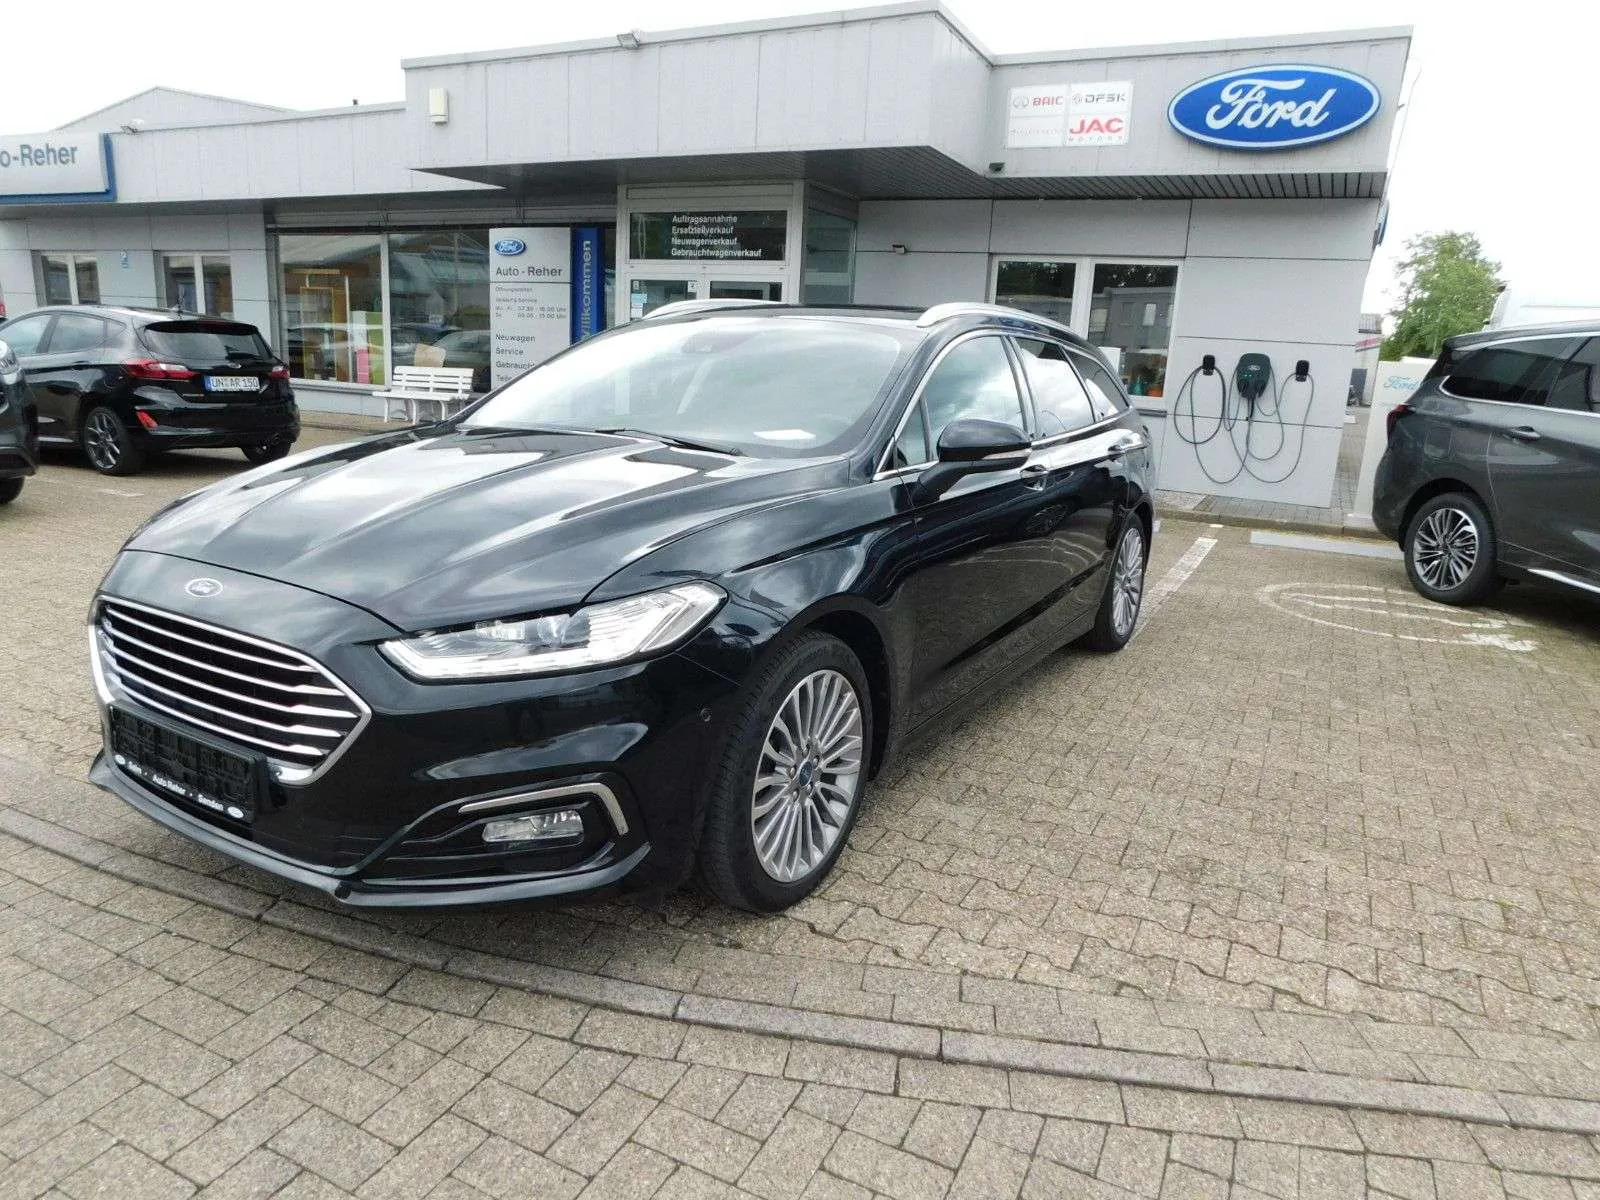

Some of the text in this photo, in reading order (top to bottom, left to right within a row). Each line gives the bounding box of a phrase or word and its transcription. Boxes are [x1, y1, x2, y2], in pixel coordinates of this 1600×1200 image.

[1032, 96, 1064, 106] BAIC
[1085, 93, 1126, 104] DFSK
[1205, 78, 1337, 130] Ford
[1069, 117, 1124, 134] JAC
[672, 215, 738, 224] Auftragsannahme
[672, 225, 734, 235] Ersatzteilverkauf
[671, 237, 738, 247] Neuwagenverkauf
[671, 248, 762, 258] Gebrauchtwagenverkauf
[496, 266, 520, 277] Auto
[527, 266, 563, 277] Reher
[495, 333, 536, 343] Neuwagen
[495, 347, 524, 355] Service
